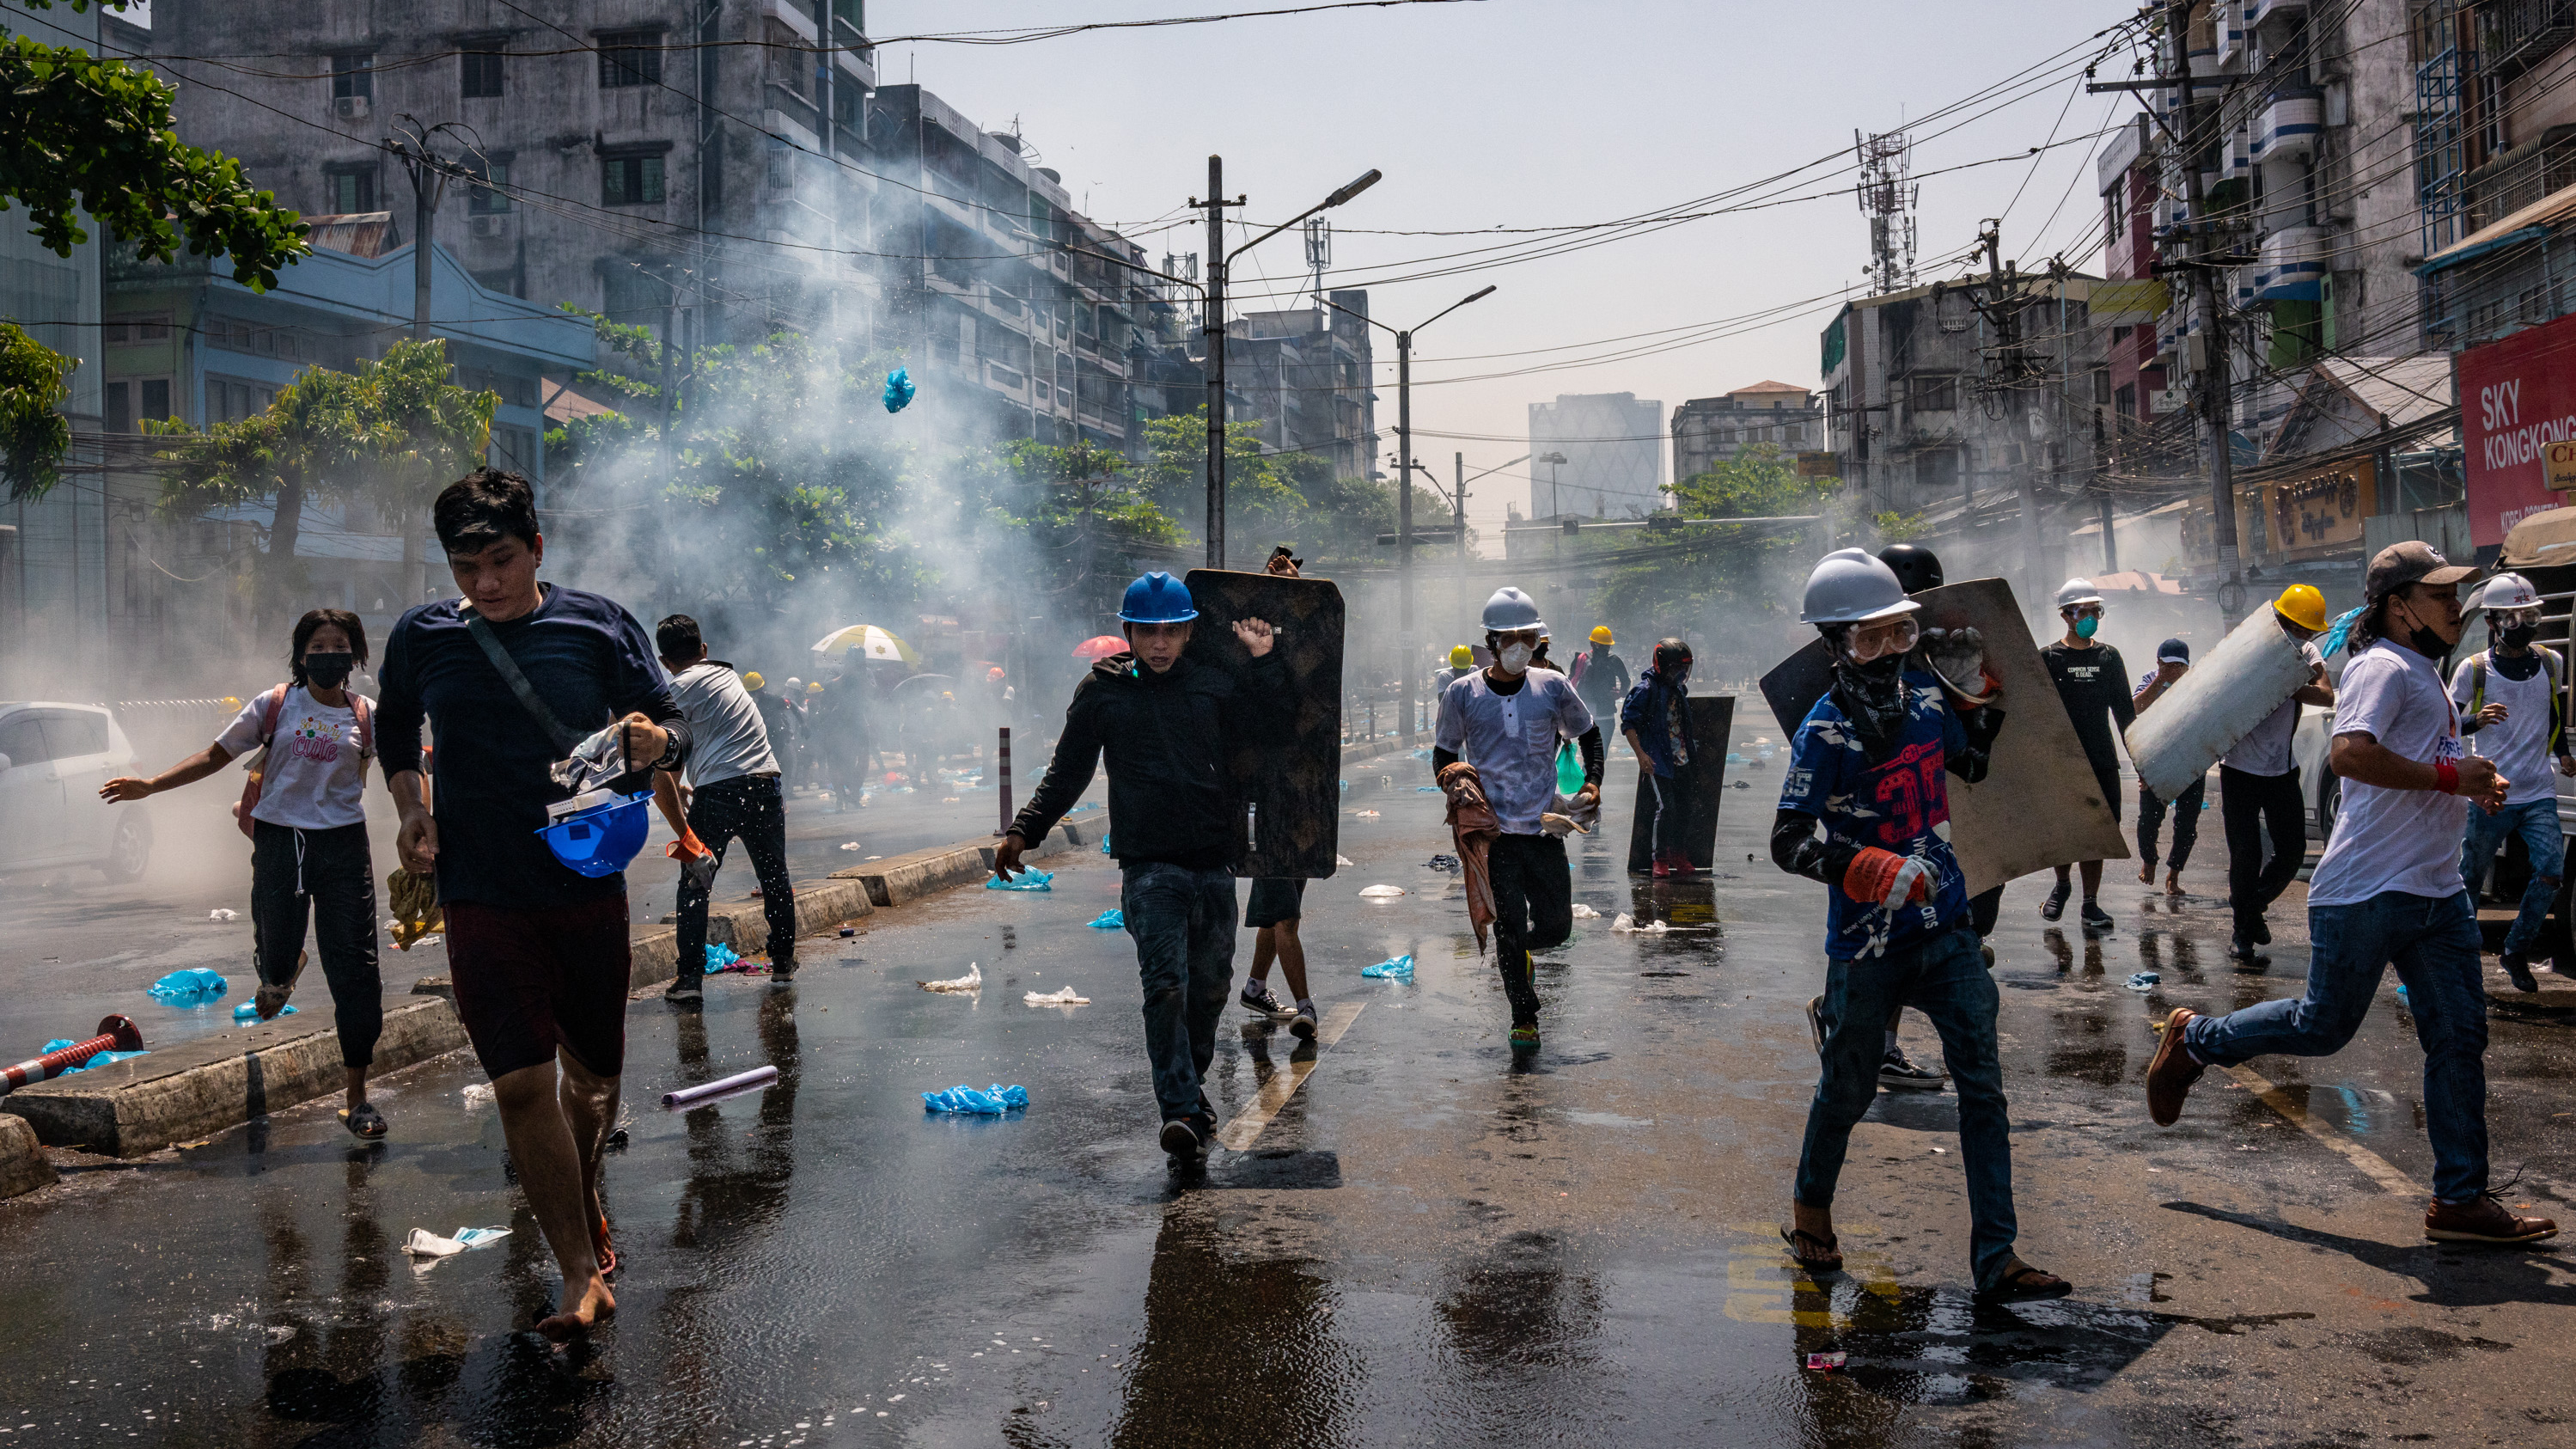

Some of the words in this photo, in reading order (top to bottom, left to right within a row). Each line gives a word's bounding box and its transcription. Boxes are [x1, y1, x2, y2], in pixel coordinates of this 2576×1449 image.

[2481, 378, 2520, 431] SKY
[1876, 748, 1950, 845] 35
[1833, 831, 1852, 844] Klein
[1851, 841, 1866, 851] Jea
[1858, 912, 1873, 924] Klein
[1920, 906, 1938, 930] ans
